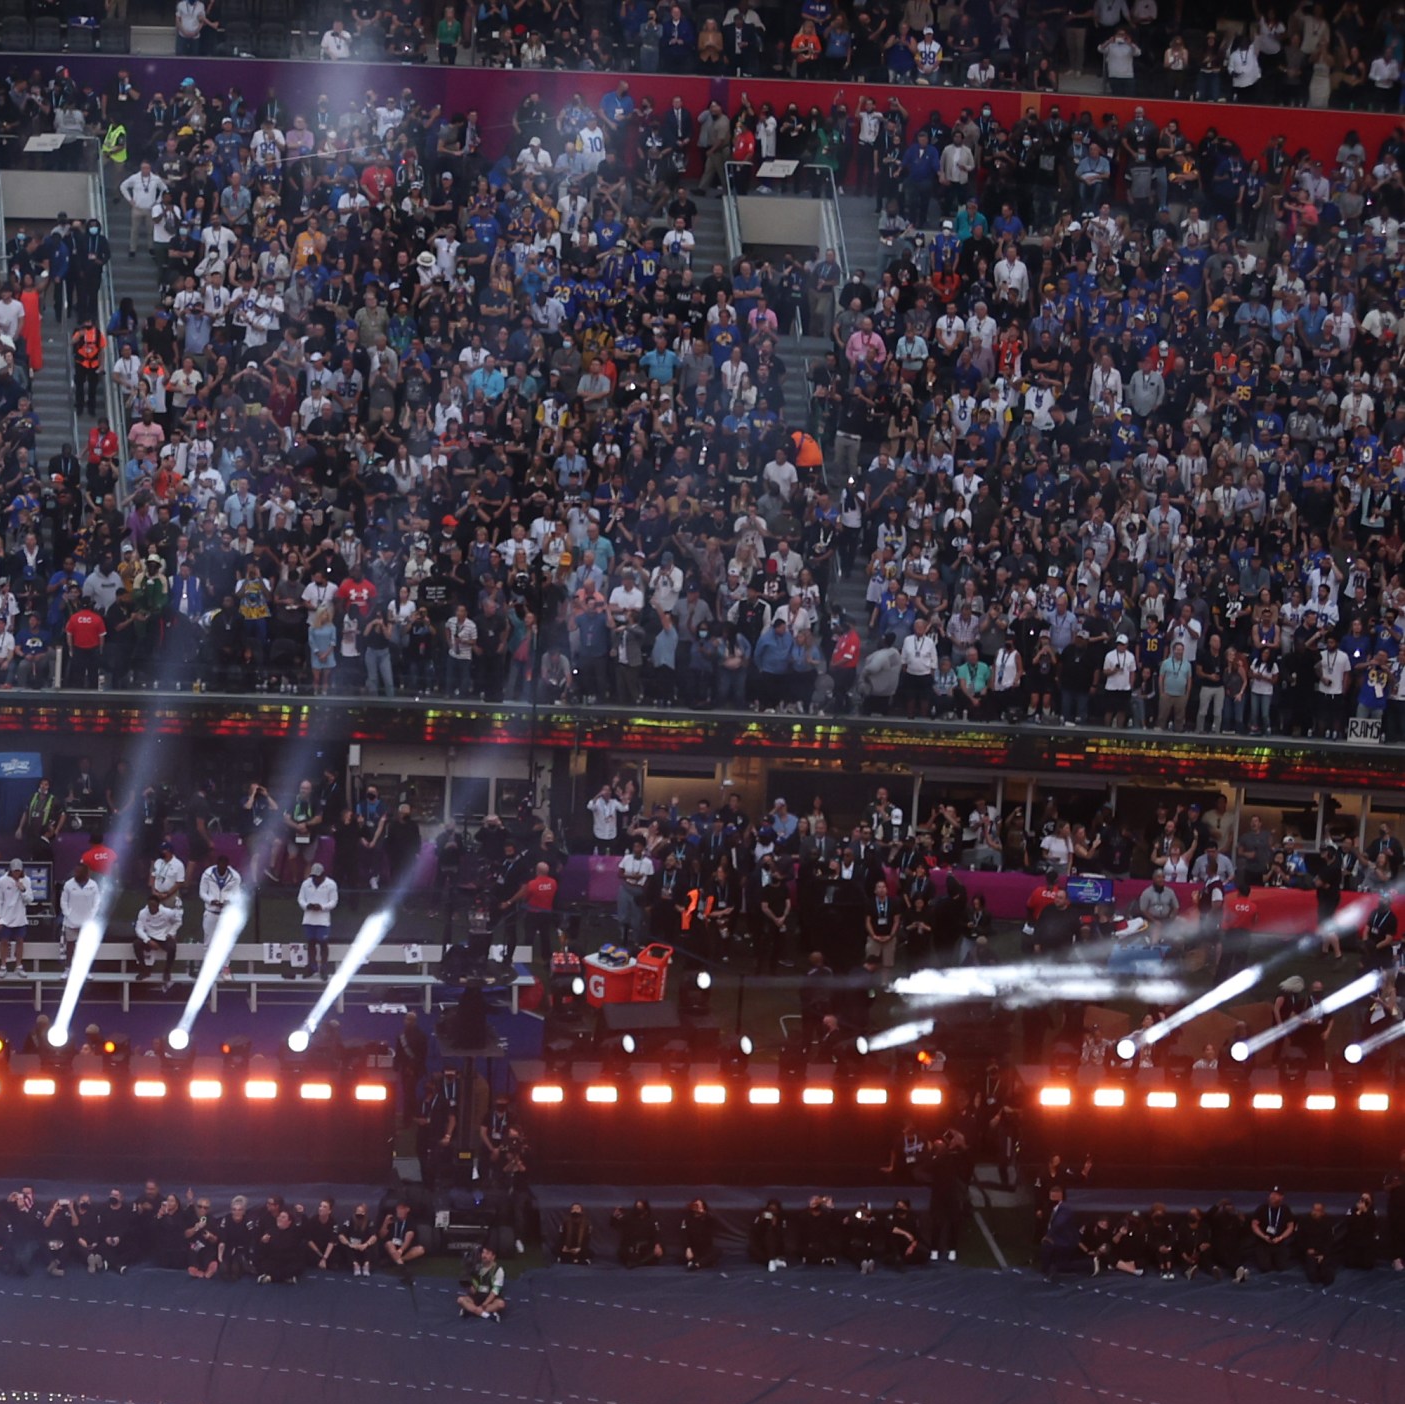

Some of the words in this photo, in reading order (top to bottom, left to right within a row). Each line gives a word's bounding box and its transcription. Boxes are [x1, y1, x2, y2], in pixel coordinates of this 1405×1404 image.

[920, 51, 935, 65] 99
[590, 136, 602, 152] 10
[302, 246, 314, 256] 24
[641, 259, 655, 276] 10
[553, 285, 571, 303] 23
[1235, 385, 1252, 400] 85
[78, 616, 92, 624] CSC
[1146, 638, 1158, 651] 16
[1350, 719, 1381, 740] RAMS
[94, 852, 108, 860] CSC
[1235, 904, 1249, 912] CSC
[589, 974, 605, 998] G
